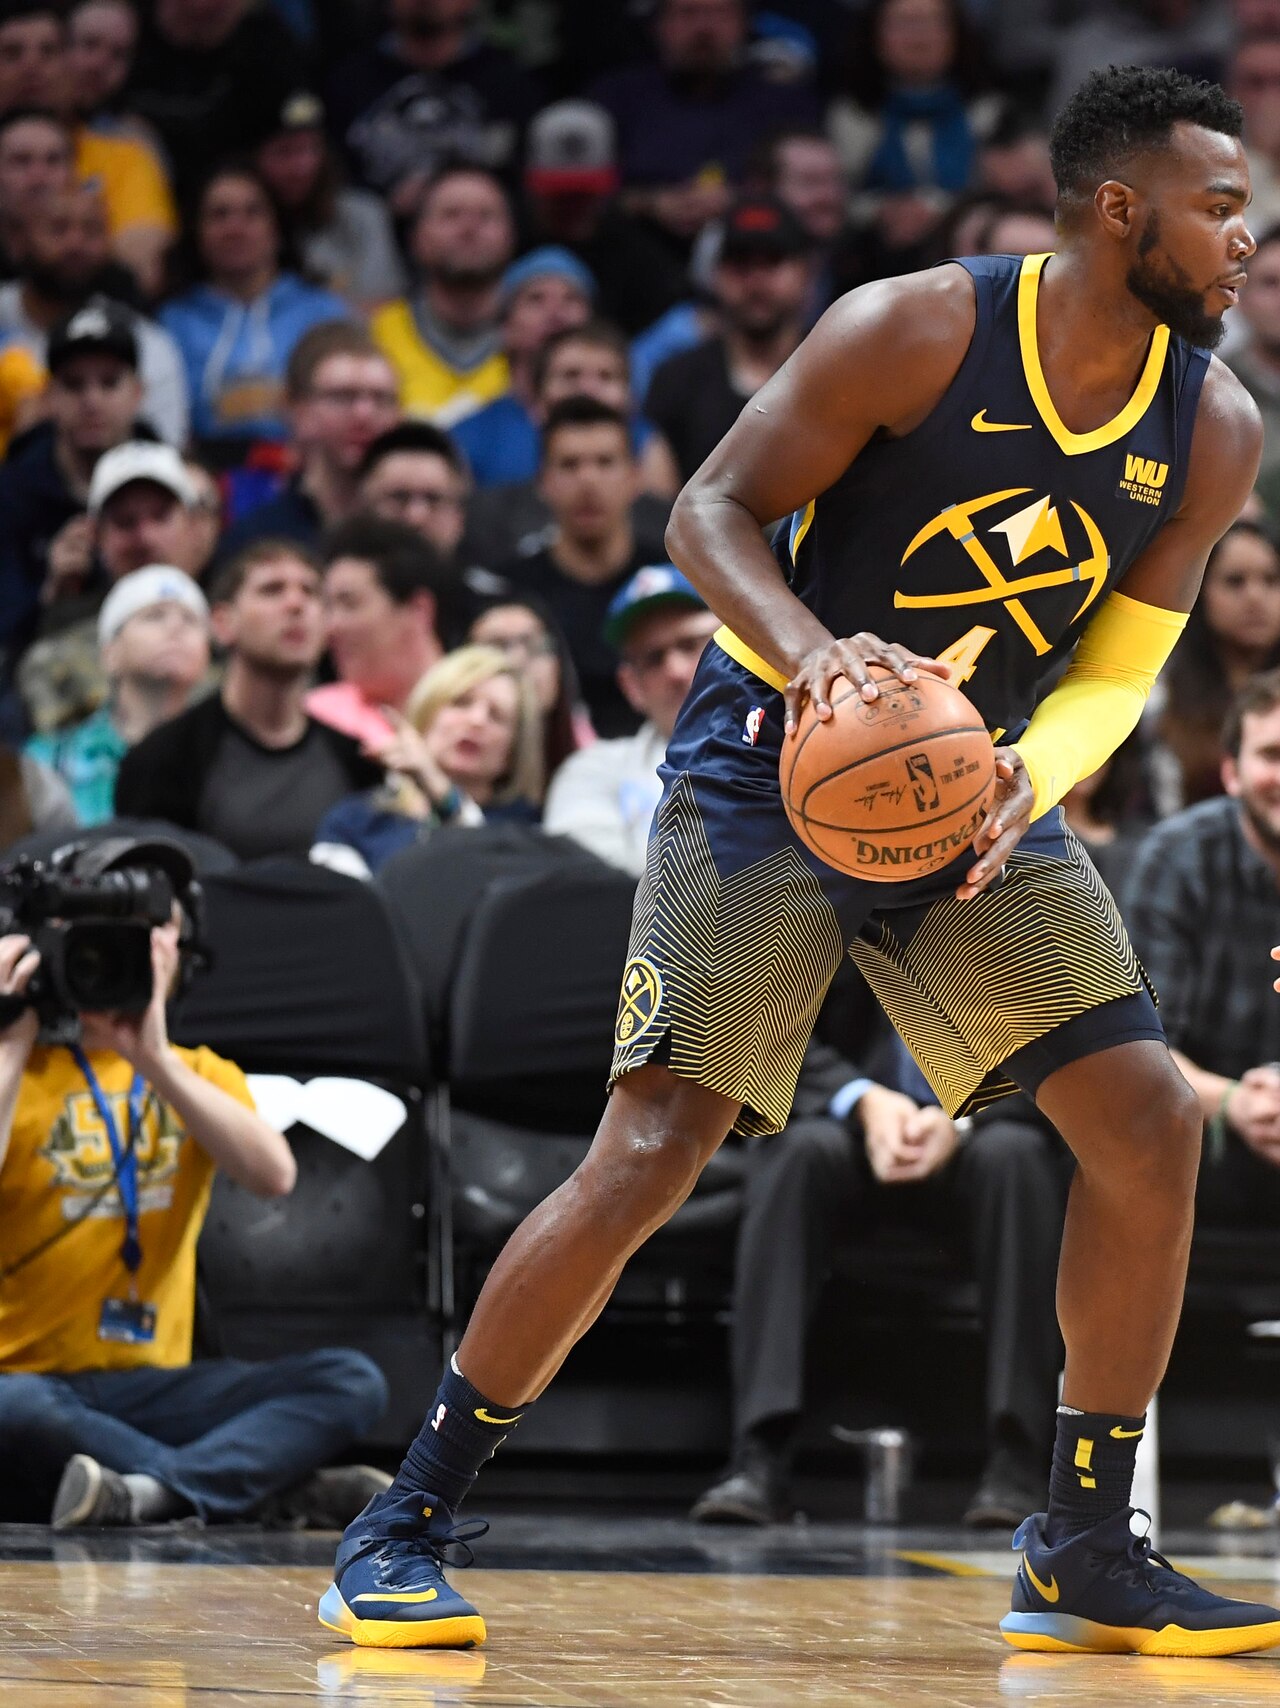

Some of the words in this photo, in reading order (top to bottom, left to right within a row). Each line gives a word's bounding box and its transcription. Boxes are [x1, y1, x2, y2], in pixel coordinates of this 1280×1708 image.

[1124, 453, 1169, 489] WU
[1119, 480, 1163, 499] WESTERN
[1129, 491, 1161, 506] UNION
[935, 625, 998, 690] 4
